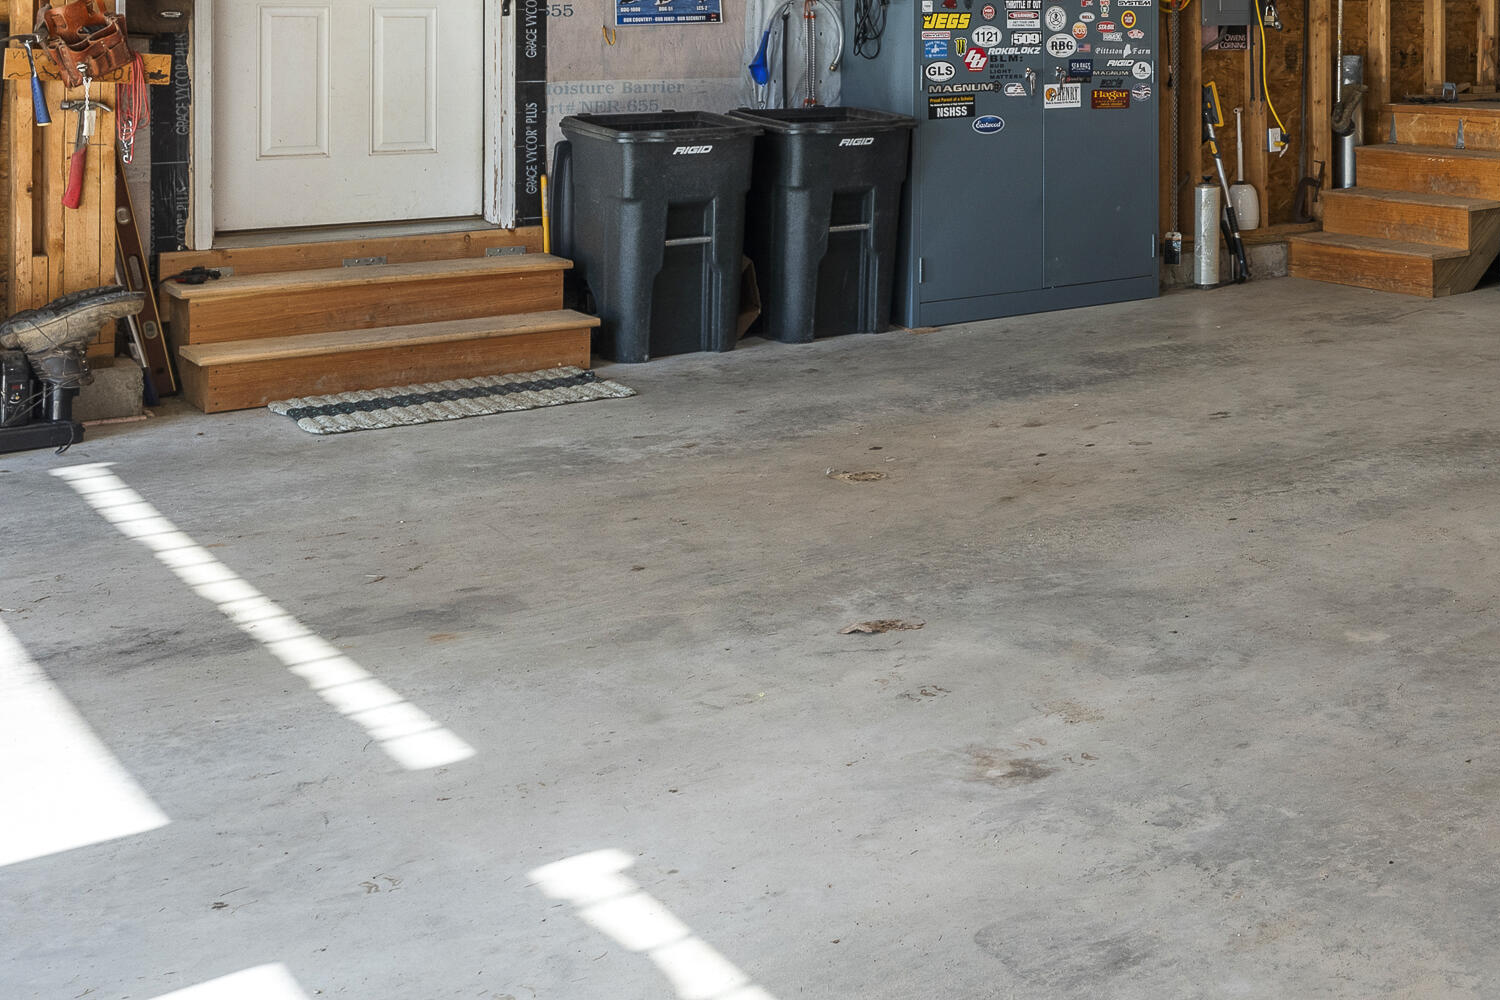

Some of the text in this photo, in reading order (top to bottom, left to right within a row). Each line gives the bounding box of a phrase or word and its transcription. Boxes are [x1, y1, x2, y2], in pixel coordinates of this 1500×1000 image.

[1006, 0, 1026, 9] THROTTLE
[923, 13, 971, 29] JEGS
[975, 31, 998, 42] 1121
[1013, 33, 1041, 44] 509
[526, 28, 537, 58] GRACE
[988, 47, 1041, 55] ROKBLOKZ
[928, 66, 953, 76] GLS
[623, 80, 685, 94] Barrier
[929, 83, 994, 93] MAGNUM
[1094, 90, 1128, 100] Hagar
[526, 102, 538, 124] PLUS
[937, 106, 967, 117] NSHSS
[976, 120, 1001, 129] Eastwood
[839, 137, 874, 146] RIGID
[673, 145, 713, 154] RIGID
[526, 164, 537, 194] GRACE
